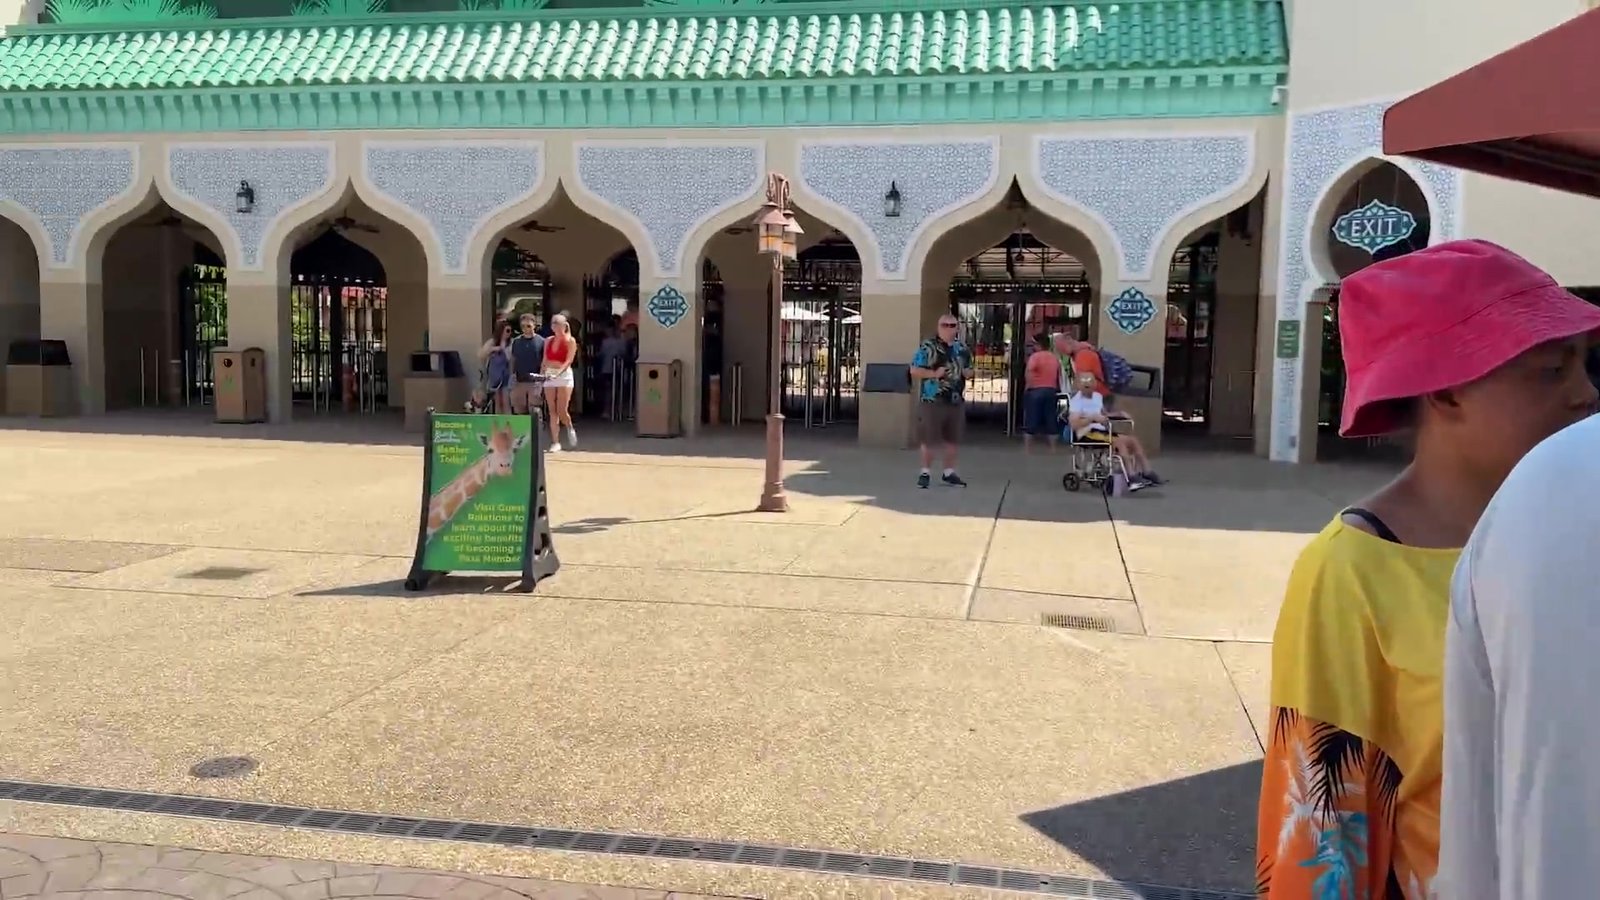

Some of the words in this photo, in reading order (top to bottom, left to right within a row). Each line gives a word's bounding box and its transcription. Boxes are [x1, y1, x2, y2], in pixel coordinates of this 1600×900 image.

[1351, 218, 1397, 237] EXIT
[660, 299, 677, 307] EXIT
[1121, 302, 1141, 310] EXIT
[474, 503, 495, 511] Visit
[498, 504, 525, 512] Guest
[468, 513, 511, 521] Relations
[451, 523, 475, 532] learn
[477, 524, 505, 532] about
[507, 524, 524, 532] the
[443, 534, 481, 544] exciting
[484, 534, 523, 542] benefits
[466, 545, 514, 555] becoming
